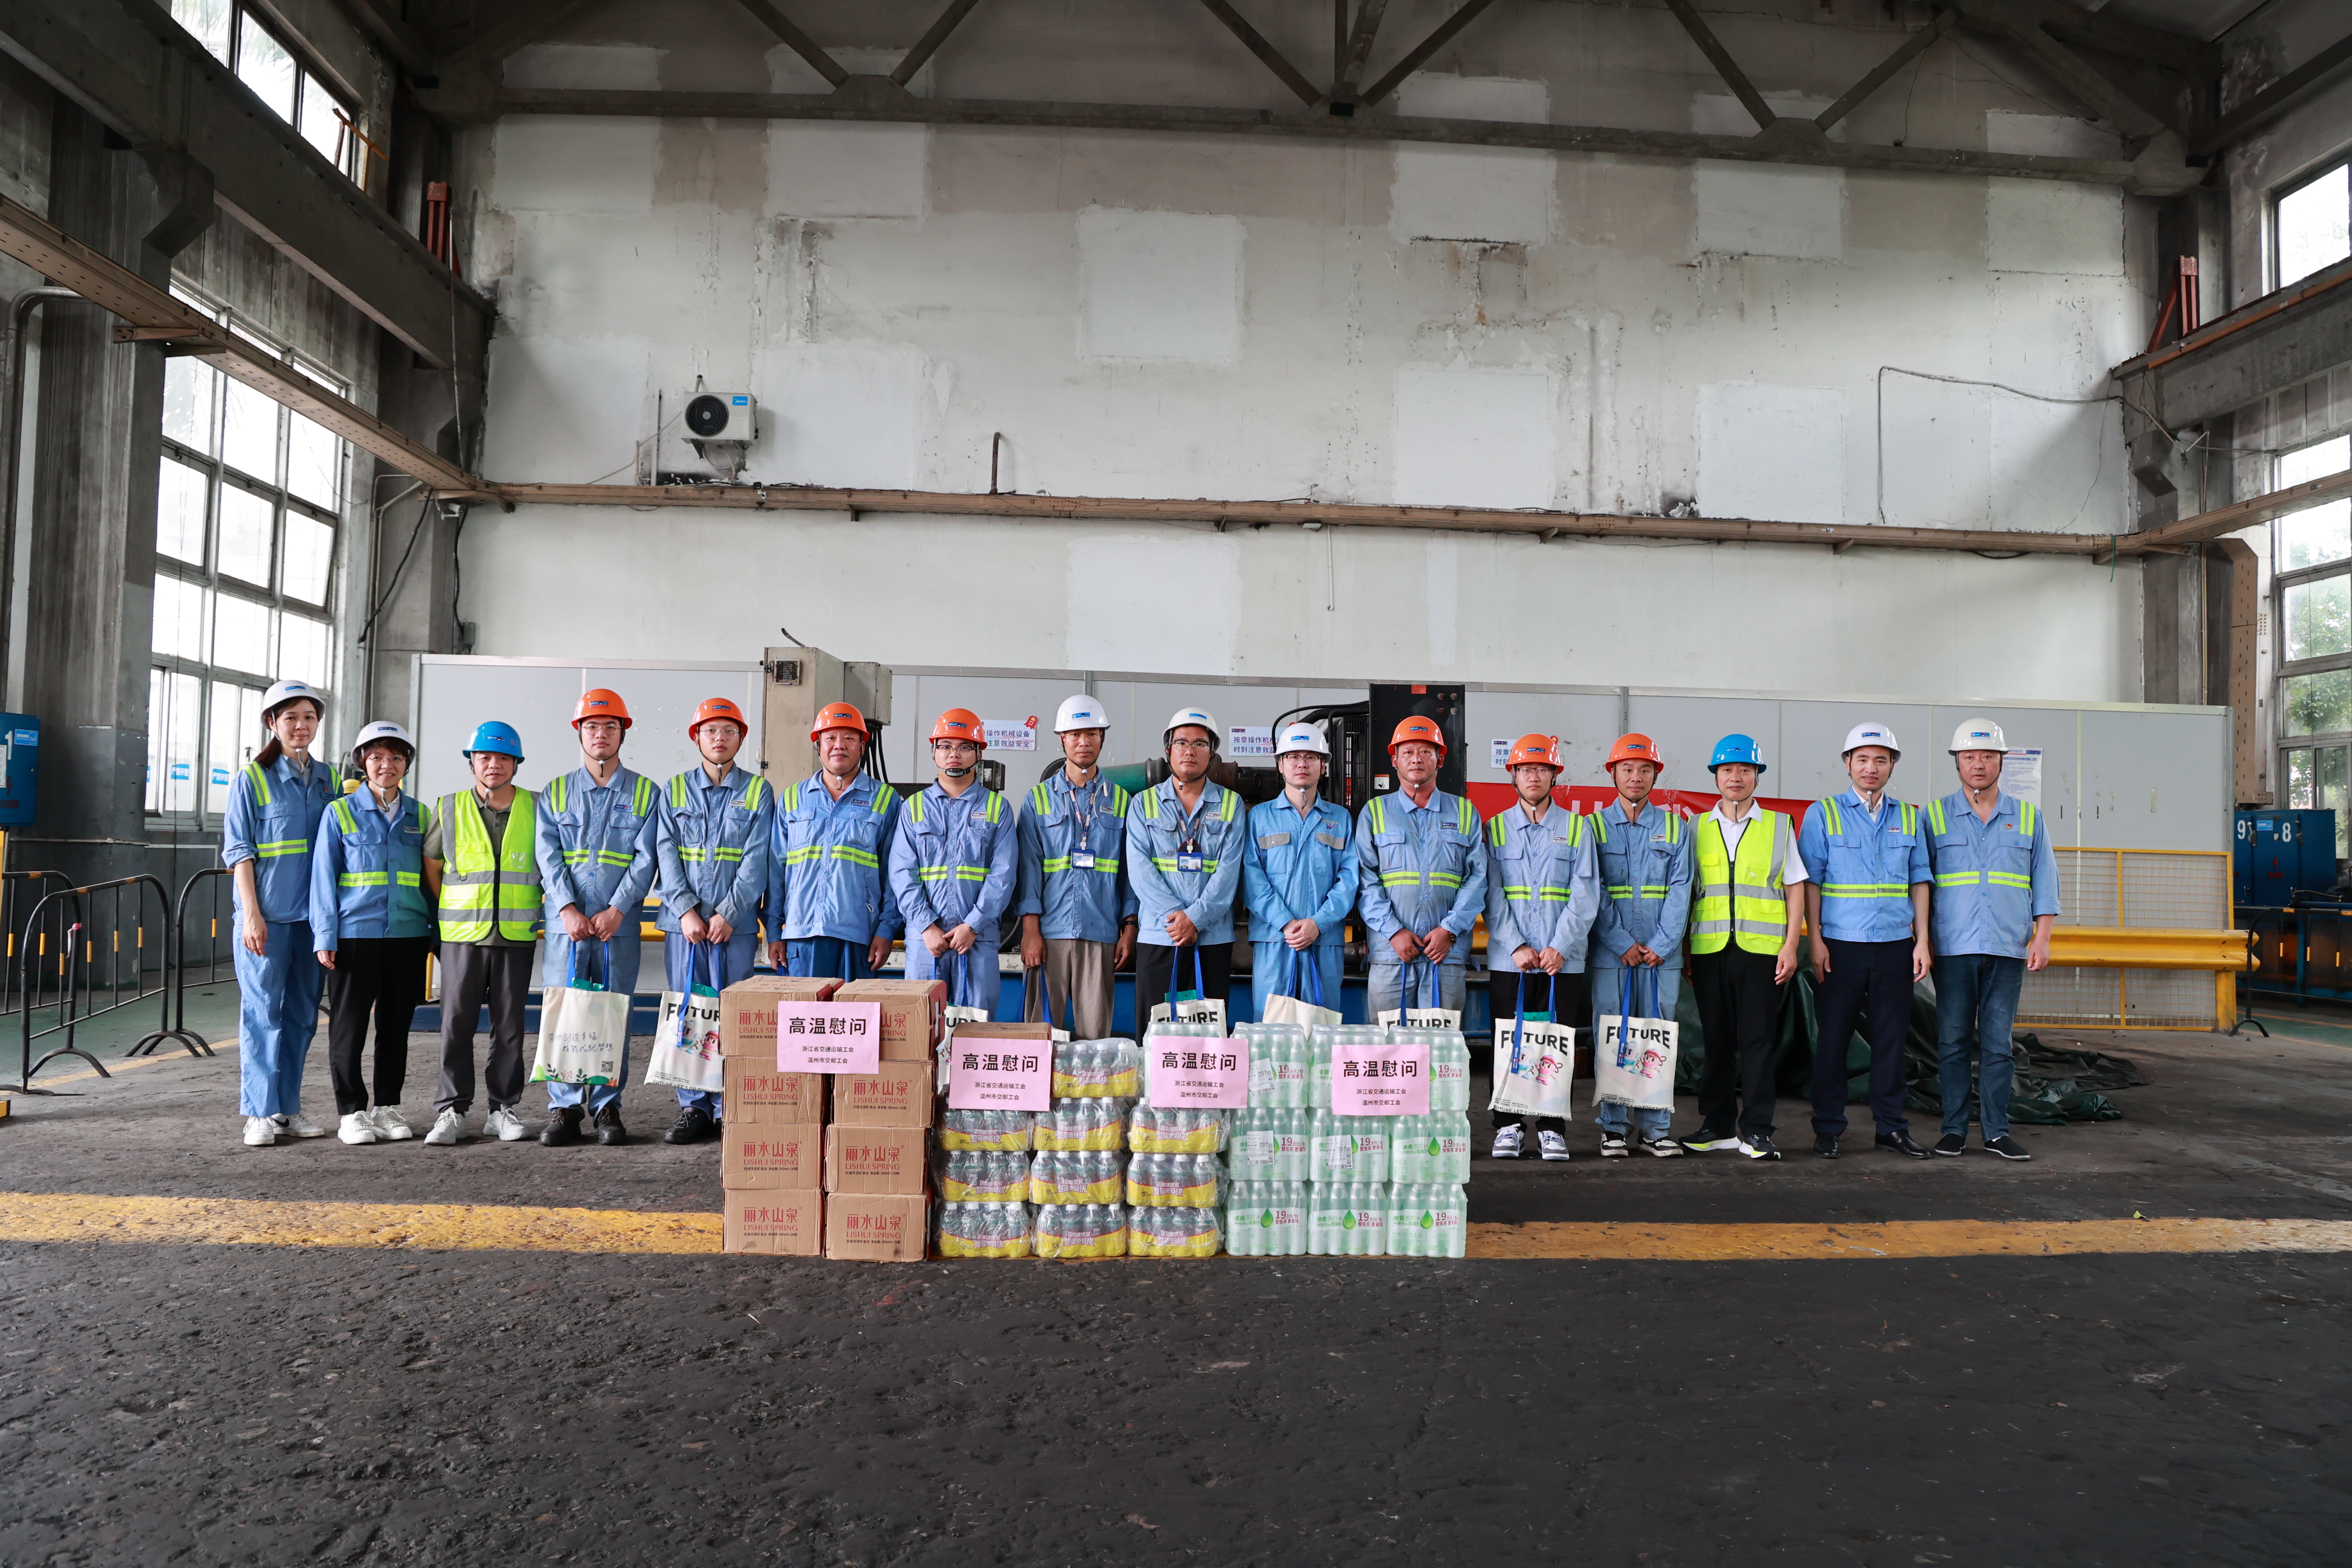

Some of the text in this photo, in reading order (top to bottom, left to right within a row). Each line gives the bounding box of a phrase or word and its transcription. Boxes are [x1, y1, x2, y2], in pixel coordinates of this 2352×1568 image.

[5, 730, 13, 760] 1
[2237, 820, 2291, 842] 9 8
[1158, 1011, 1218, 1023] TURE
[1387, 1018, 1452, 1032] FTURE
[789, 1017, 866, 1035] 高温慰问
[548, 1032, 597, 1042] 劳动创造幸福
[963, 1053, 1038, 1072] 高温慰问
[1162, 1051, 1236, 1071] 高温慰问
[1343, 1060, 1417, 1077] 高温慰问
[1438, 1065, 1462, 1073] 19.9元/包
[744, 1075, 798, 1092] 丽水山泉
[854, 1080, 908, 1096] 丽水山泉
[1360, 1137, 1383, 1146] 19.9元/包
[1442, 1139, 1466, 1148] 19.9元/包
[744, 1142, 798, 1158] 丽水山泉
[846, 1145, 900, 1162] 丽水山泉
[744, 1207, 798, 1223] 丽水山泉
[847, 1214, 901, 1231] 丽水山泉
[1358, 1212, 1383, 1222] 19.9元/包
